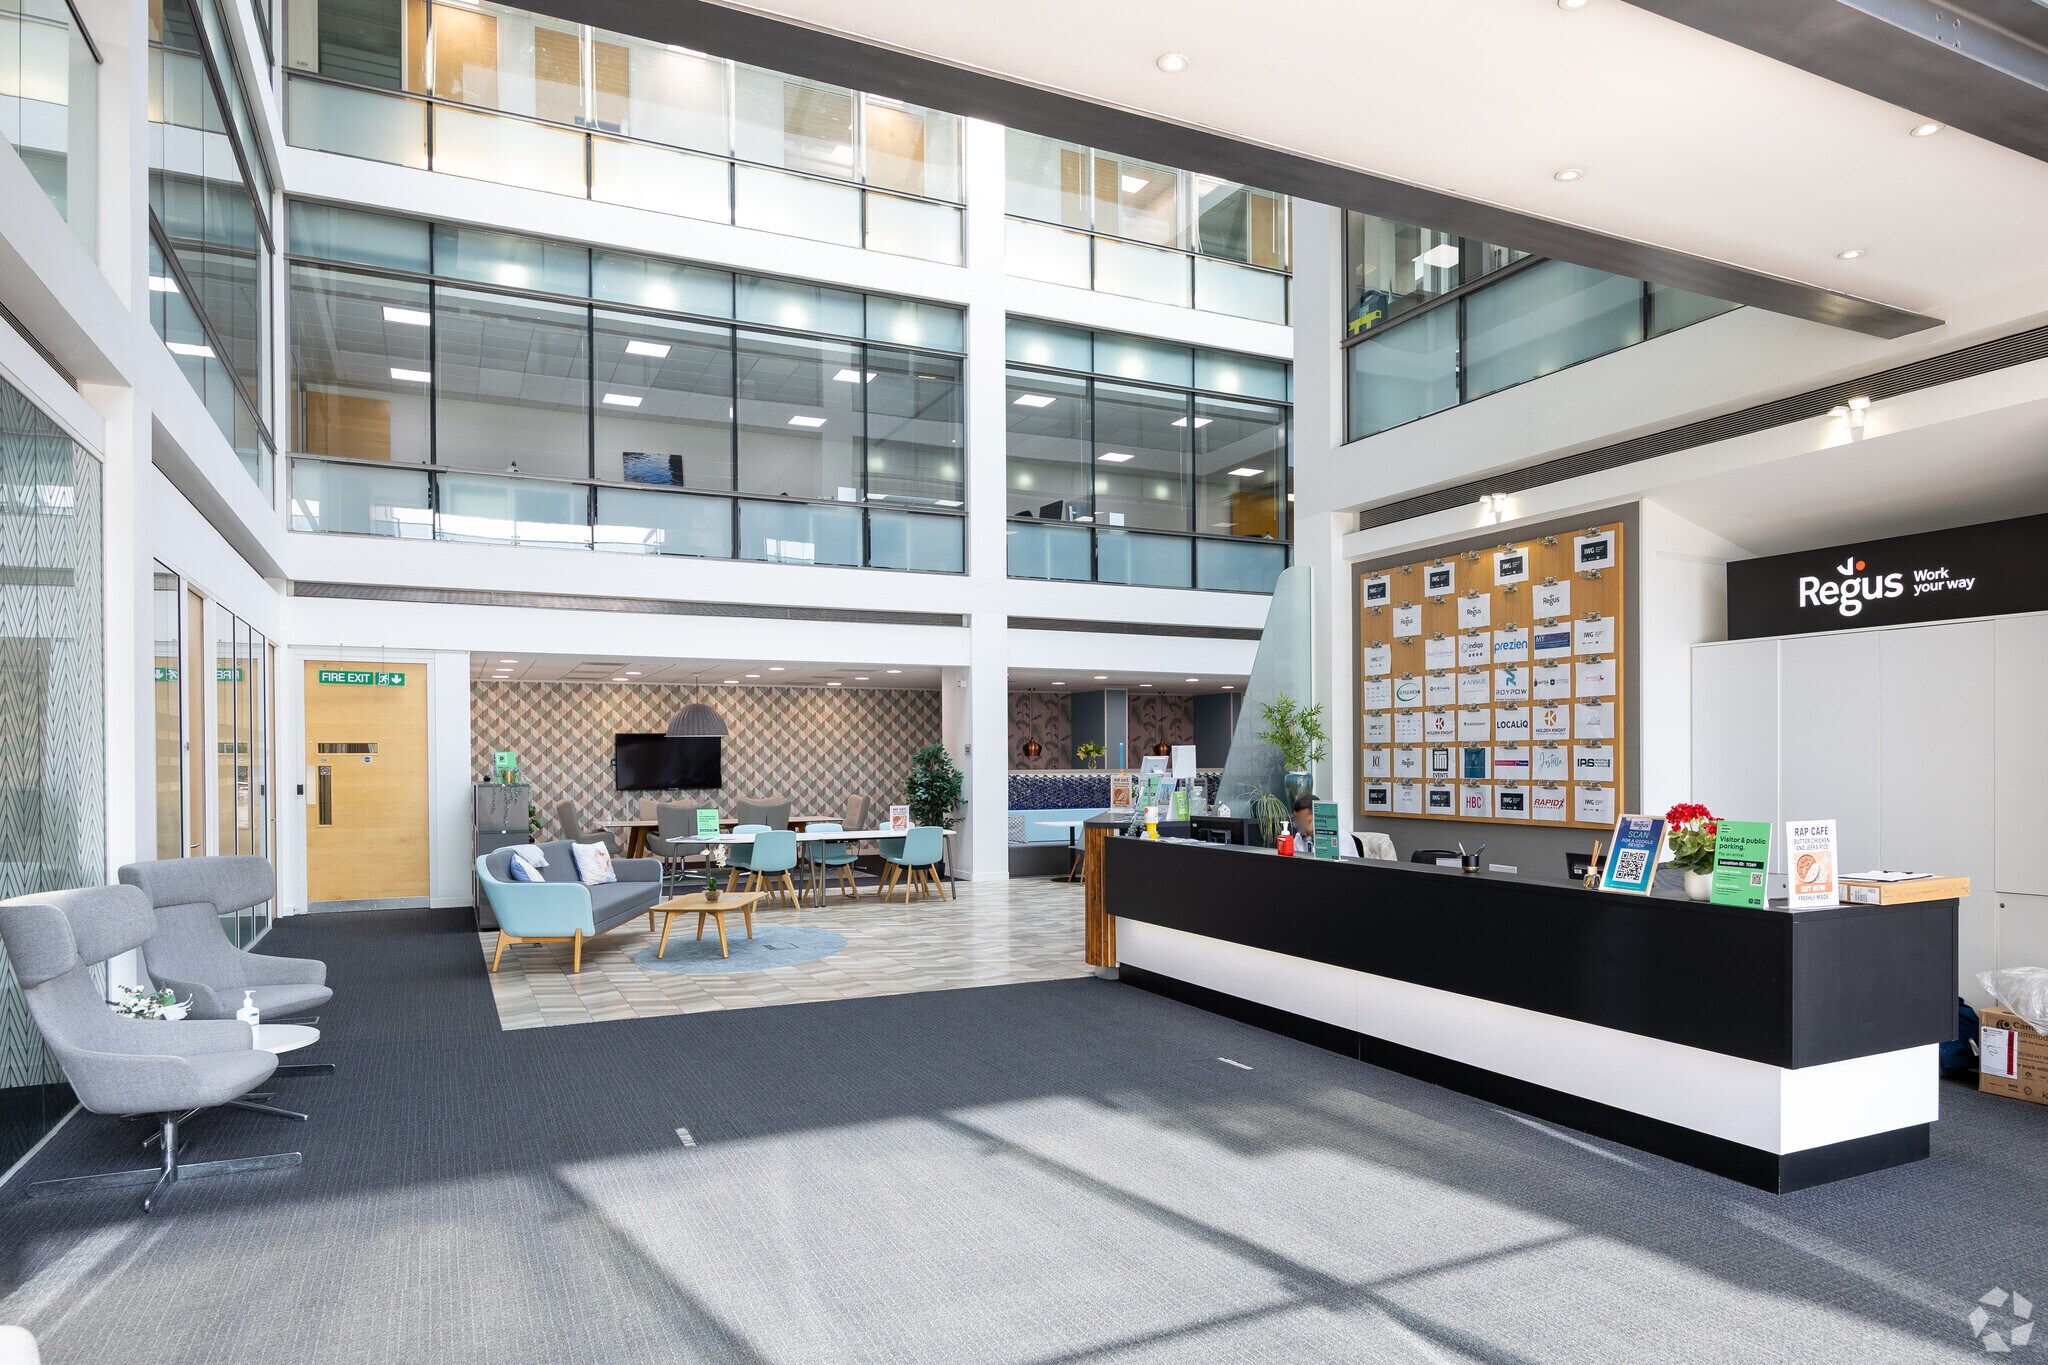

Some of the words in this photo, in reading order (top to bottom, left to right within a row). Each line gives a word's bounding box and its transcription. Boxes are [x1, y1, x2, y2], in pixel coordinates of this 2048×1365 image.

[1914, 567, 1949, 582] Work
[1914, 580, 1943, 596] your
[1947, 578, 1975, 591] way
[1800, 573, 1904, 616] Regus
[1543, 597, 1560, 606] Regus
[1466, 609, 1482, 617] Regus
[1494, 638, 1528, 653] prezien
[322, 672, 345, 682] FIRE
[348, 674, 370, 683] EXIT
[1466, 796, 1482, 808] HBC
[1633, 821, 1649, 829] Regus
[1795, 828, 1808, 836] RAP
